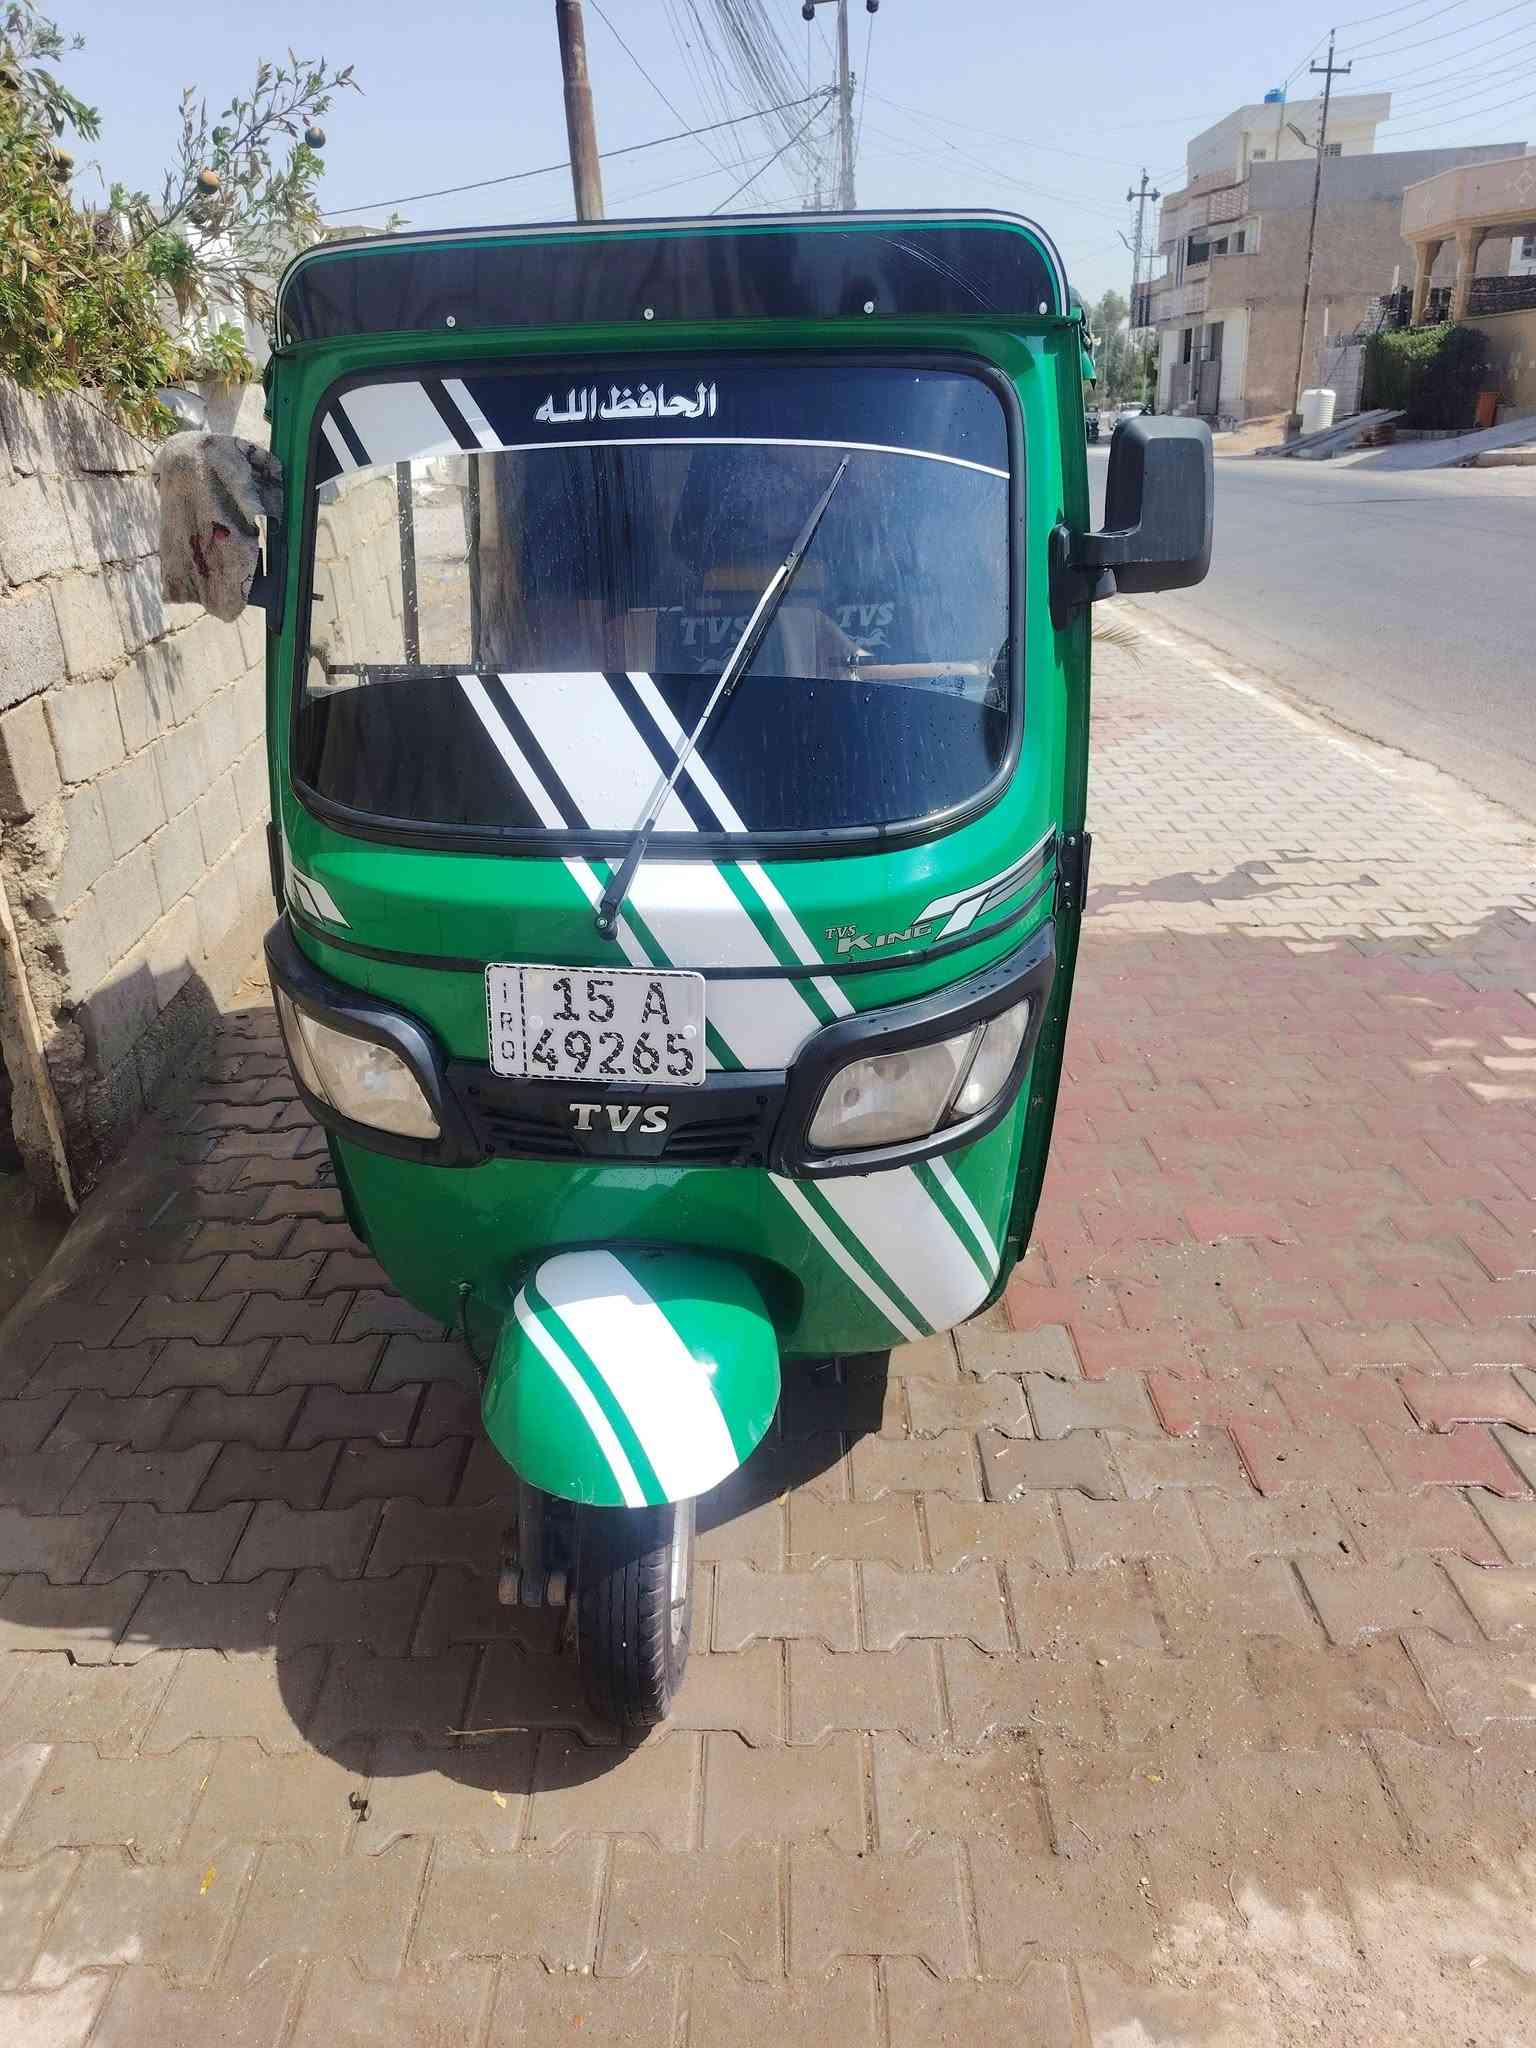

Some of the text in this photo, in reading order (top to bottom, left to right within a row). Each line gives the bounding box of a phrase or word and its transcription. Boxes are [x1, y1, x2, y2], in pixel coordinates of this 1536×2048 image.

[534, 381, 717, 422] الحافظ الله
[836, 602, 896, 628] TVS
[825, 925, 857, 939] TVS
[837, 923, 932, 954] KING
[552, 977, 670, 1025] 15 A
[531, 1028, 695, 1077] 49265
[569, 1102, 671, 1134] TVS
